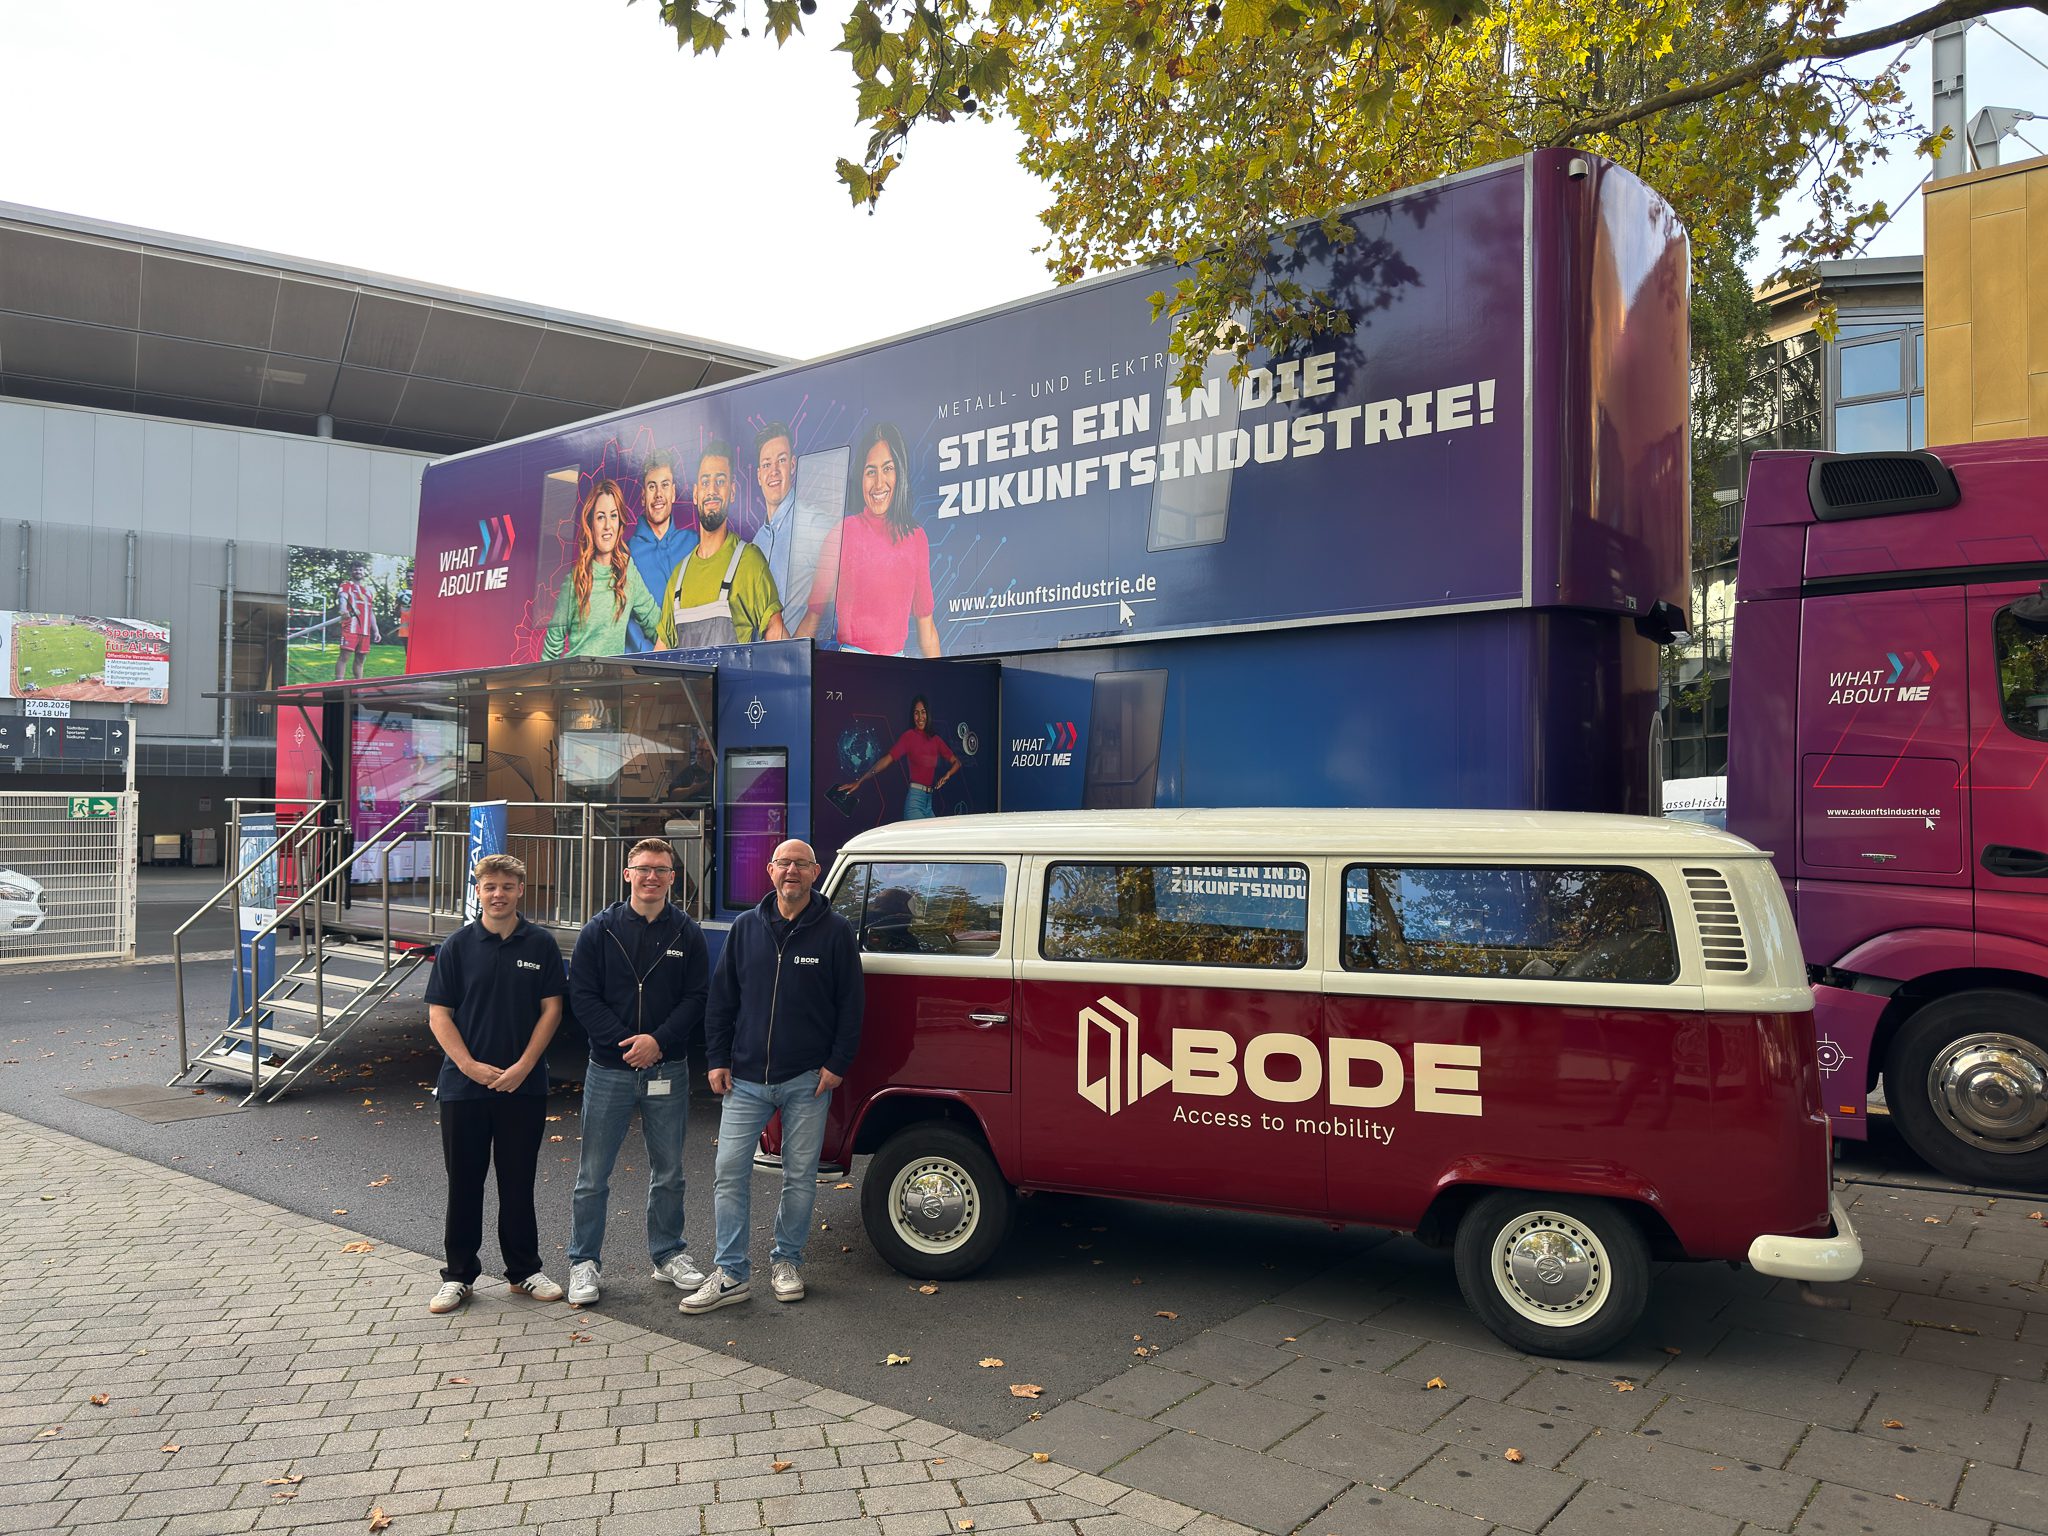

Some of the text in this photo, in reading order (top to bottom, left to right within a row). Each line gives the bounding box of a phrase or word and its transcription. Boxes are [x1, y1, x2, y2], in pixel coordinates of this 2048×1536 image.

[938, 391, 1017, 419] METALL-
[1031, 376, 1069, 398] UND
[938, 352, 1336, 472] STEIG EIN IN DIE
[938, 378, 1496, 519] ZUKUNFTSINDUSTRIE!
[440, 546, 478, 572] WHAT
[438, 566, 509, 598] ABOUT ME
[949, 574, 1157, 613] www.zukunftsindustrie.de
[105, 626, 167, 640] Sportfest
[106, 640, 161, 653] für ALLE
[1829, 670, 1884, 687] WHAT
[1828, 685, 1931, 705] ABOUT ME
[26, 701, 70, 709] 27.08.2026
[54, 709, 68, 717] Uhr
[1012, 738, 1045, 752] WHAT
[1011, 752, 1072, 767] ABOUT ME
[1663, 797, 1726, 810] assel-tisch
[1827, 807, 1941, 816] www.zukunftsindustrie.de
[1227, 867, 1259, 879] EIN
[1263, 867, 1284, 880] IN
[1172, 1027, 1483, 1117] BODE
[1173, 1105, 1396, 1146] Access to mobility
